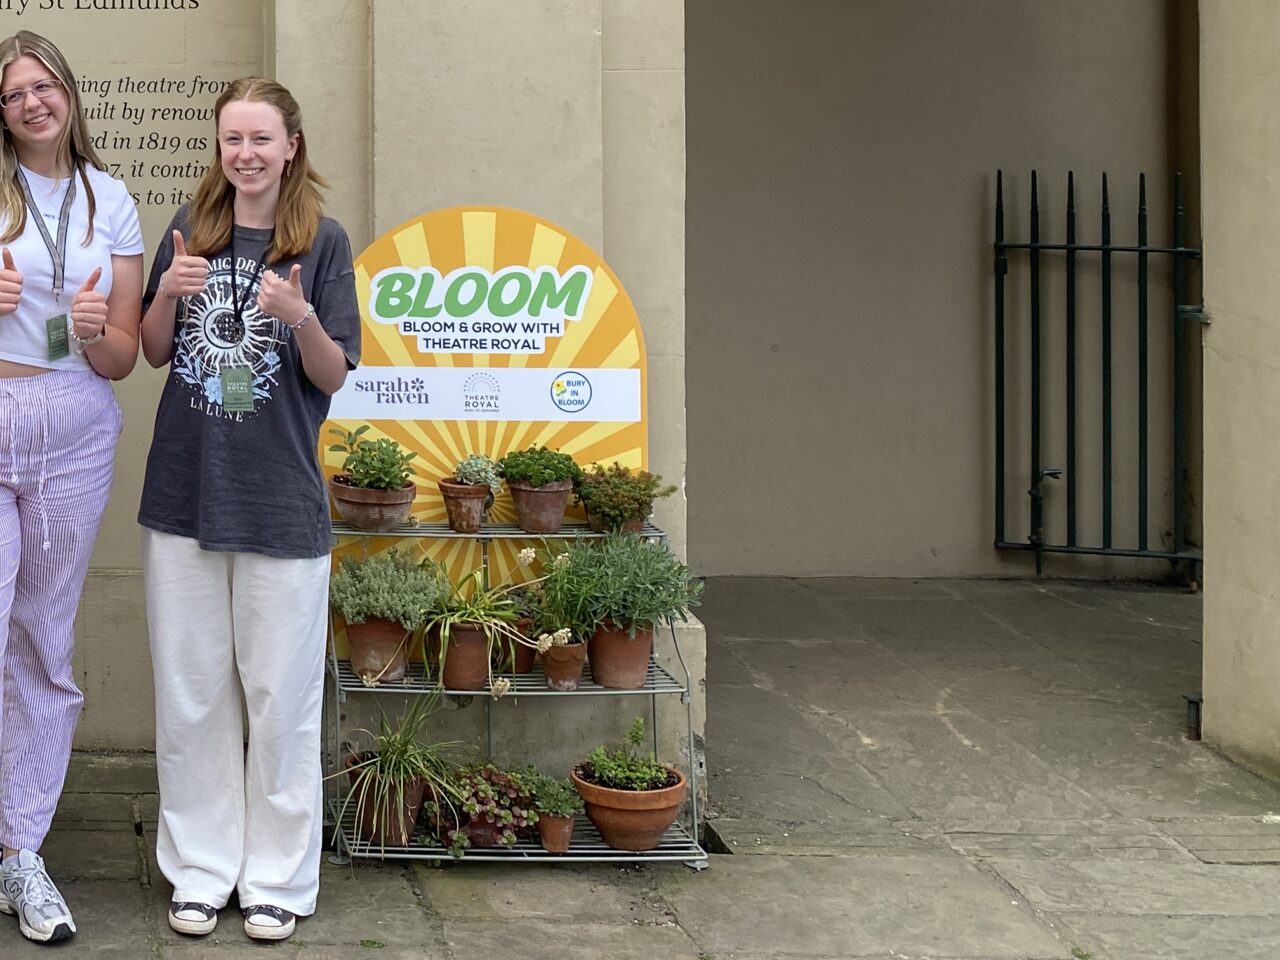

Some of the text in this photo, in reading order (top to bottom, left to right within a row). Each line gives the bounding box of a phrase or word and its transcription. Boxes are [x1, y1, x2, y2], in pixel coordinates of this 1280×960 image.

[117, 76, 185, 94] theatre
[84, 102, 116, 121] uilt
[122, 102, 145, 125] by
[151, 107, 214, 121] renow
[113, 131, 131, 150] in
[137, 132, 181, 155] 1819
[186, 136, 207, 150] as
[131, 160, 145, 178] it
[147, 190, 165, 205] to
[374, 271, 587, 318] BLOOM
[403, 321, 560, 334] BLOOM & GROW WITH
[423, 338, 540, 350] THEATRE ROYAL
[355, 377, 410, 392] sarah
[376, 390, 430, 404] raven
